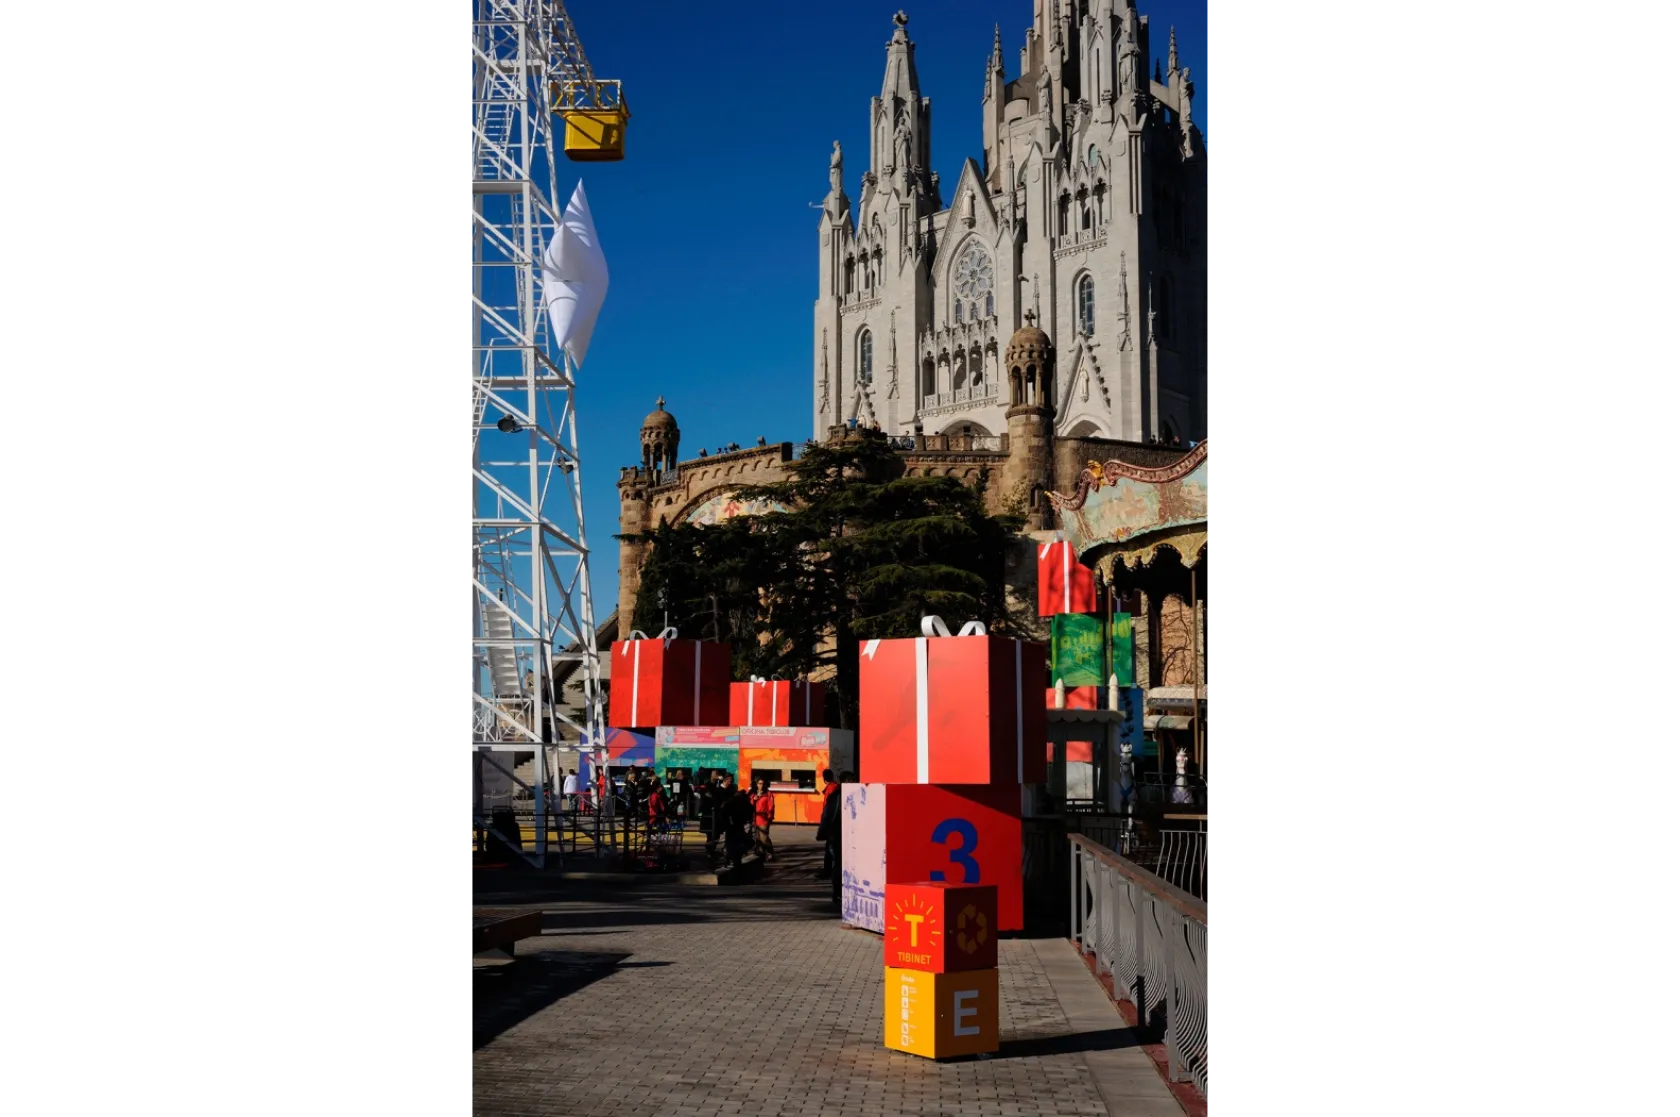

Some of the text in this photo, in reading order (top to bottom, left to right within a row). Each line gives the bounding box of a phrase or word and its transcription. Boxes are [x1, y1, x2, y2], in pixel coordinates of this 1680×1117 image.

[930, 818, 980, 883] 3
[904, 913, 924, 948] T
[897, 951, 932, 965] TIBINET
[954, 989, 980, 1037] E
